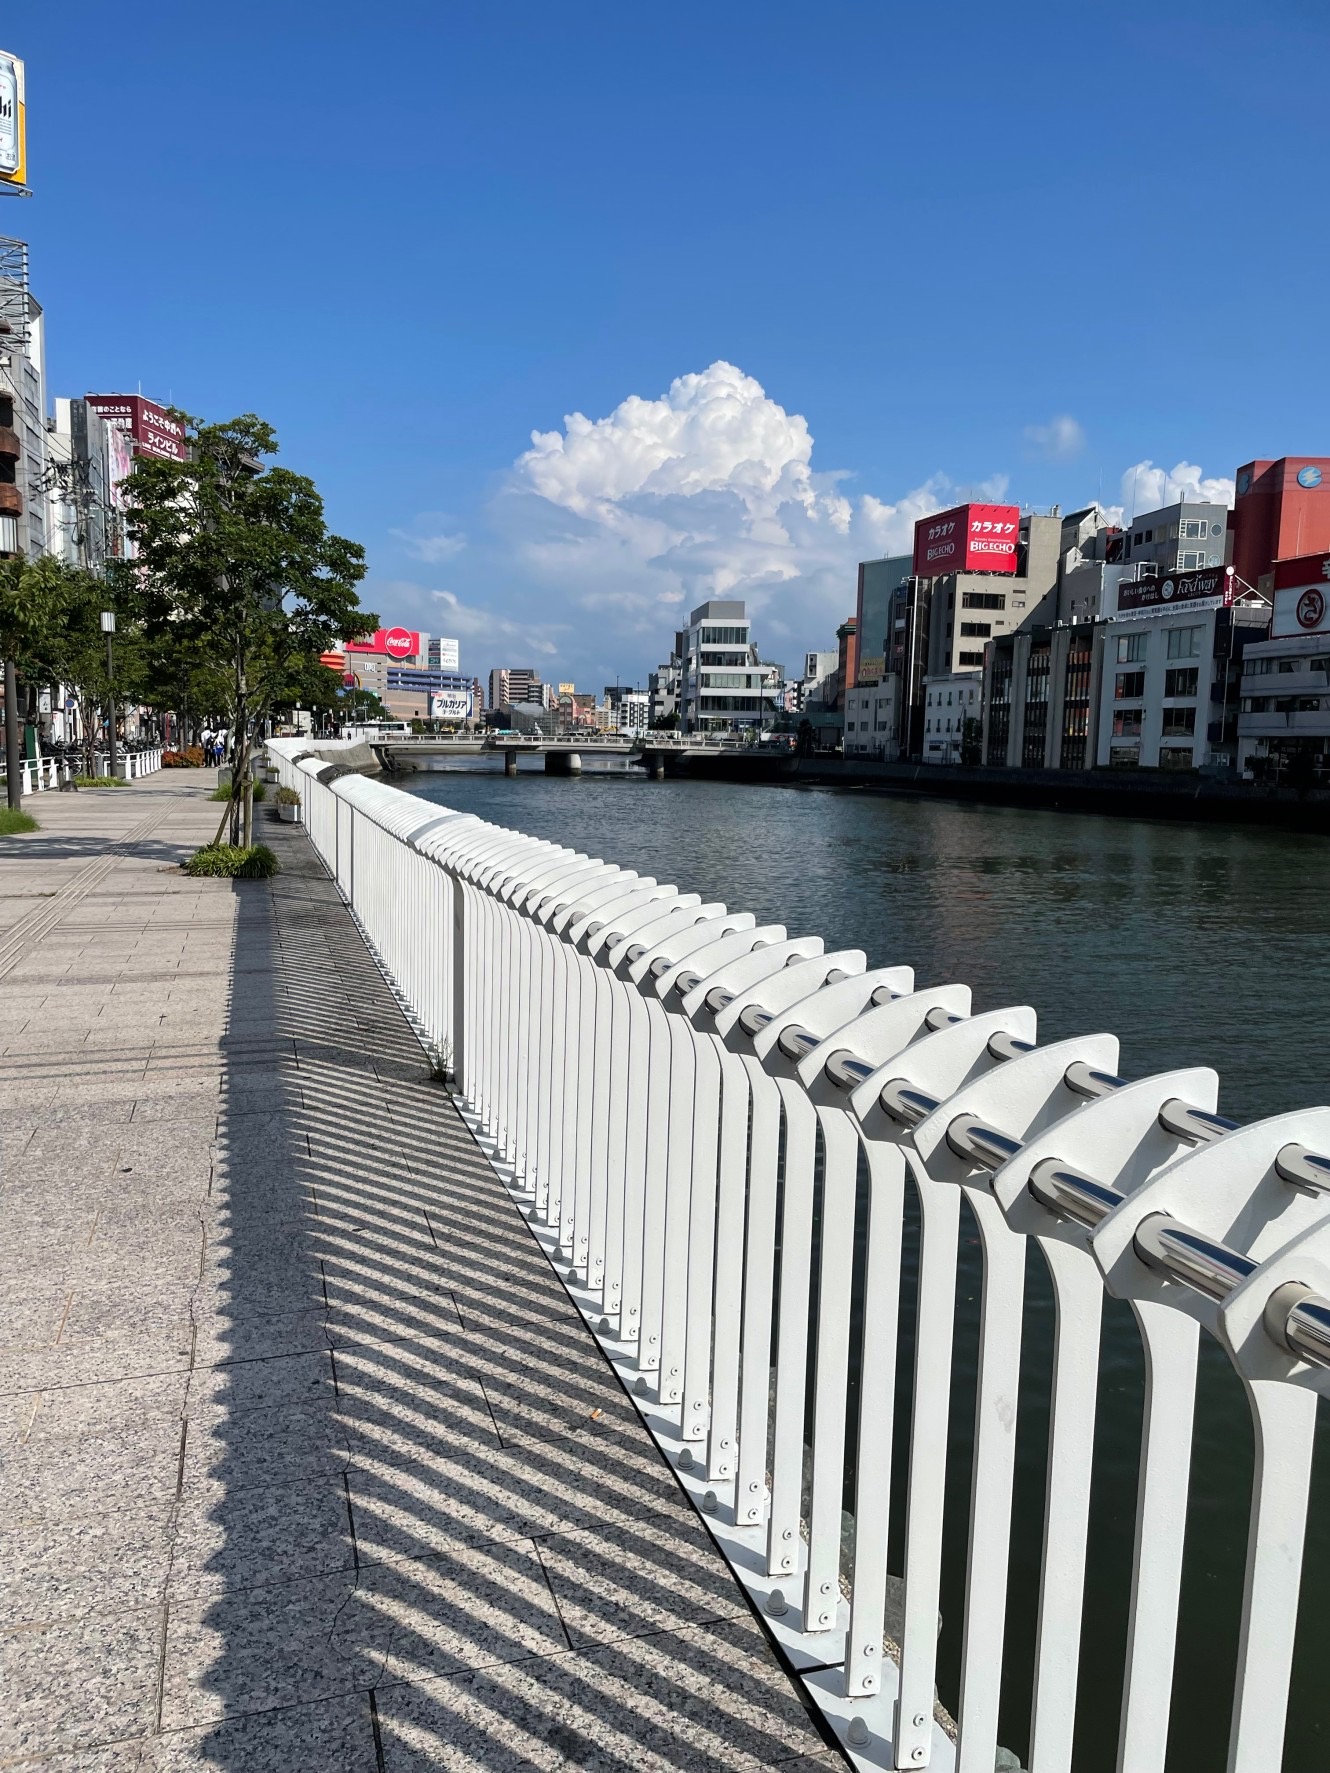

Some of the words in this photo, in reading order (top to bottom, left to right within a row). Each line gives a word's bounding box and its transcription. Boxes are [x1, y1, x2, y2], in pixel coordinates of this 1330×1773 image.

[148, 432, 178, 454] ラインビル
[928, 522, 956, 540] カラオケ
[971, 522, 1016, 534] カラオケ
[927, 548, 939, 560] BIG
[939, 543, 955, 556] ECHO
[971, 541, 988, 552] BIG
[990, 542, 1015, 554] ECHO
[386, 637, 411, 648] Coca-Cola
